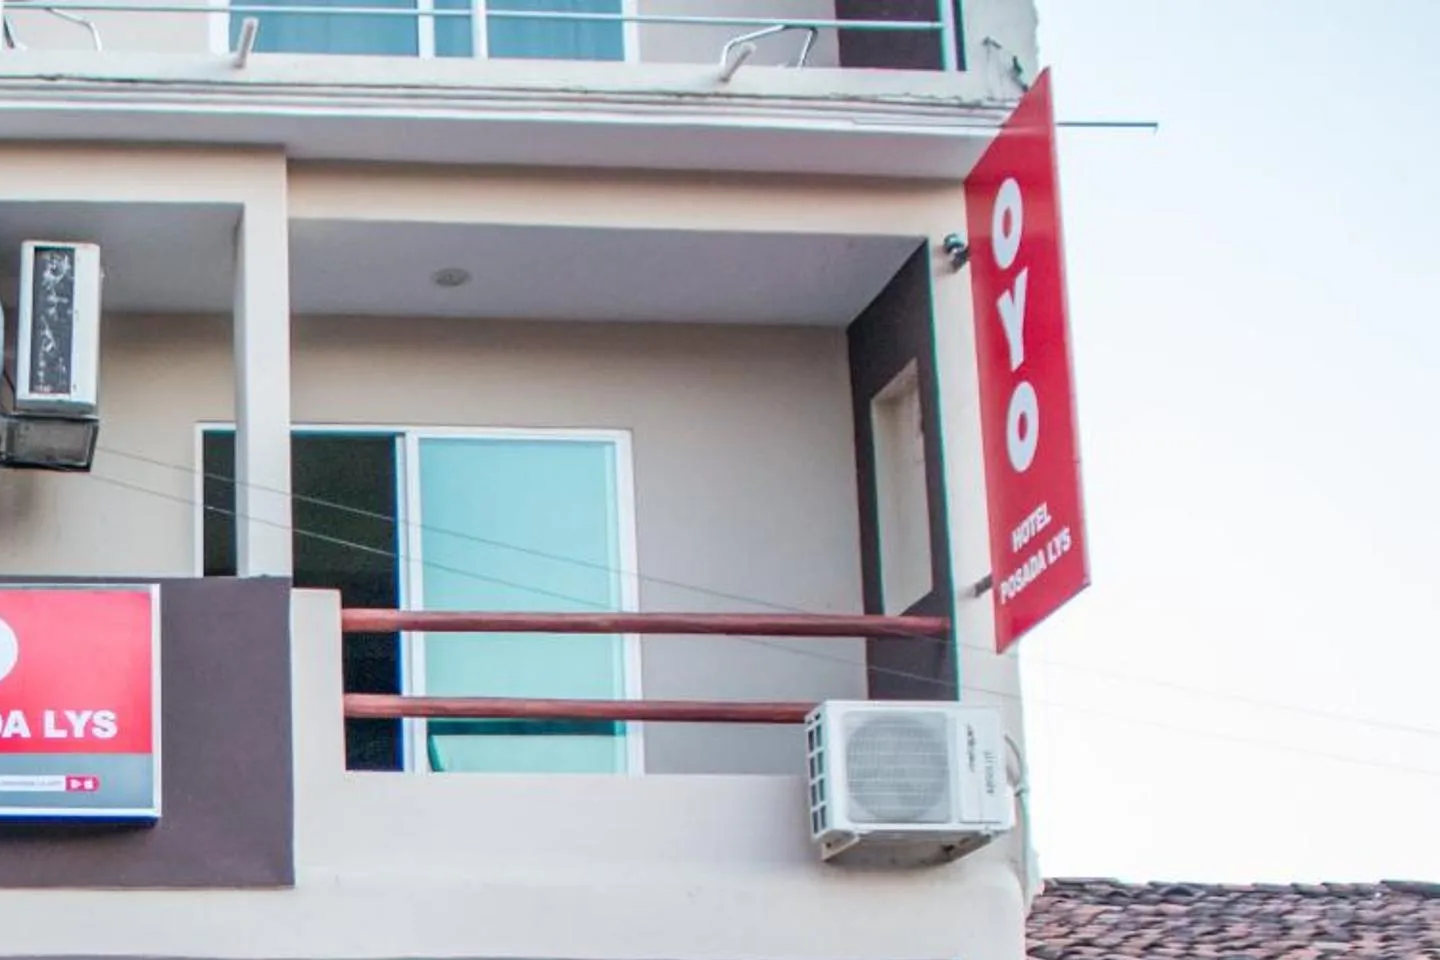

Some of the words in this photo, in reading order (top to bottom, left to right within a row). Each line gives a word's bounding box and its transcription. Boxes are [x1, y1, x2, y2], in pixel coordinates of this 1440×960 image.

[992, 177, 1039, 473] OYO
[1012, 501, 1052, 553] HOTEL
[1001, 548, 1047, 605] POSADA
[1047, 526, 1072, 566] LYS
[44, 710, 118, 739] LYS
